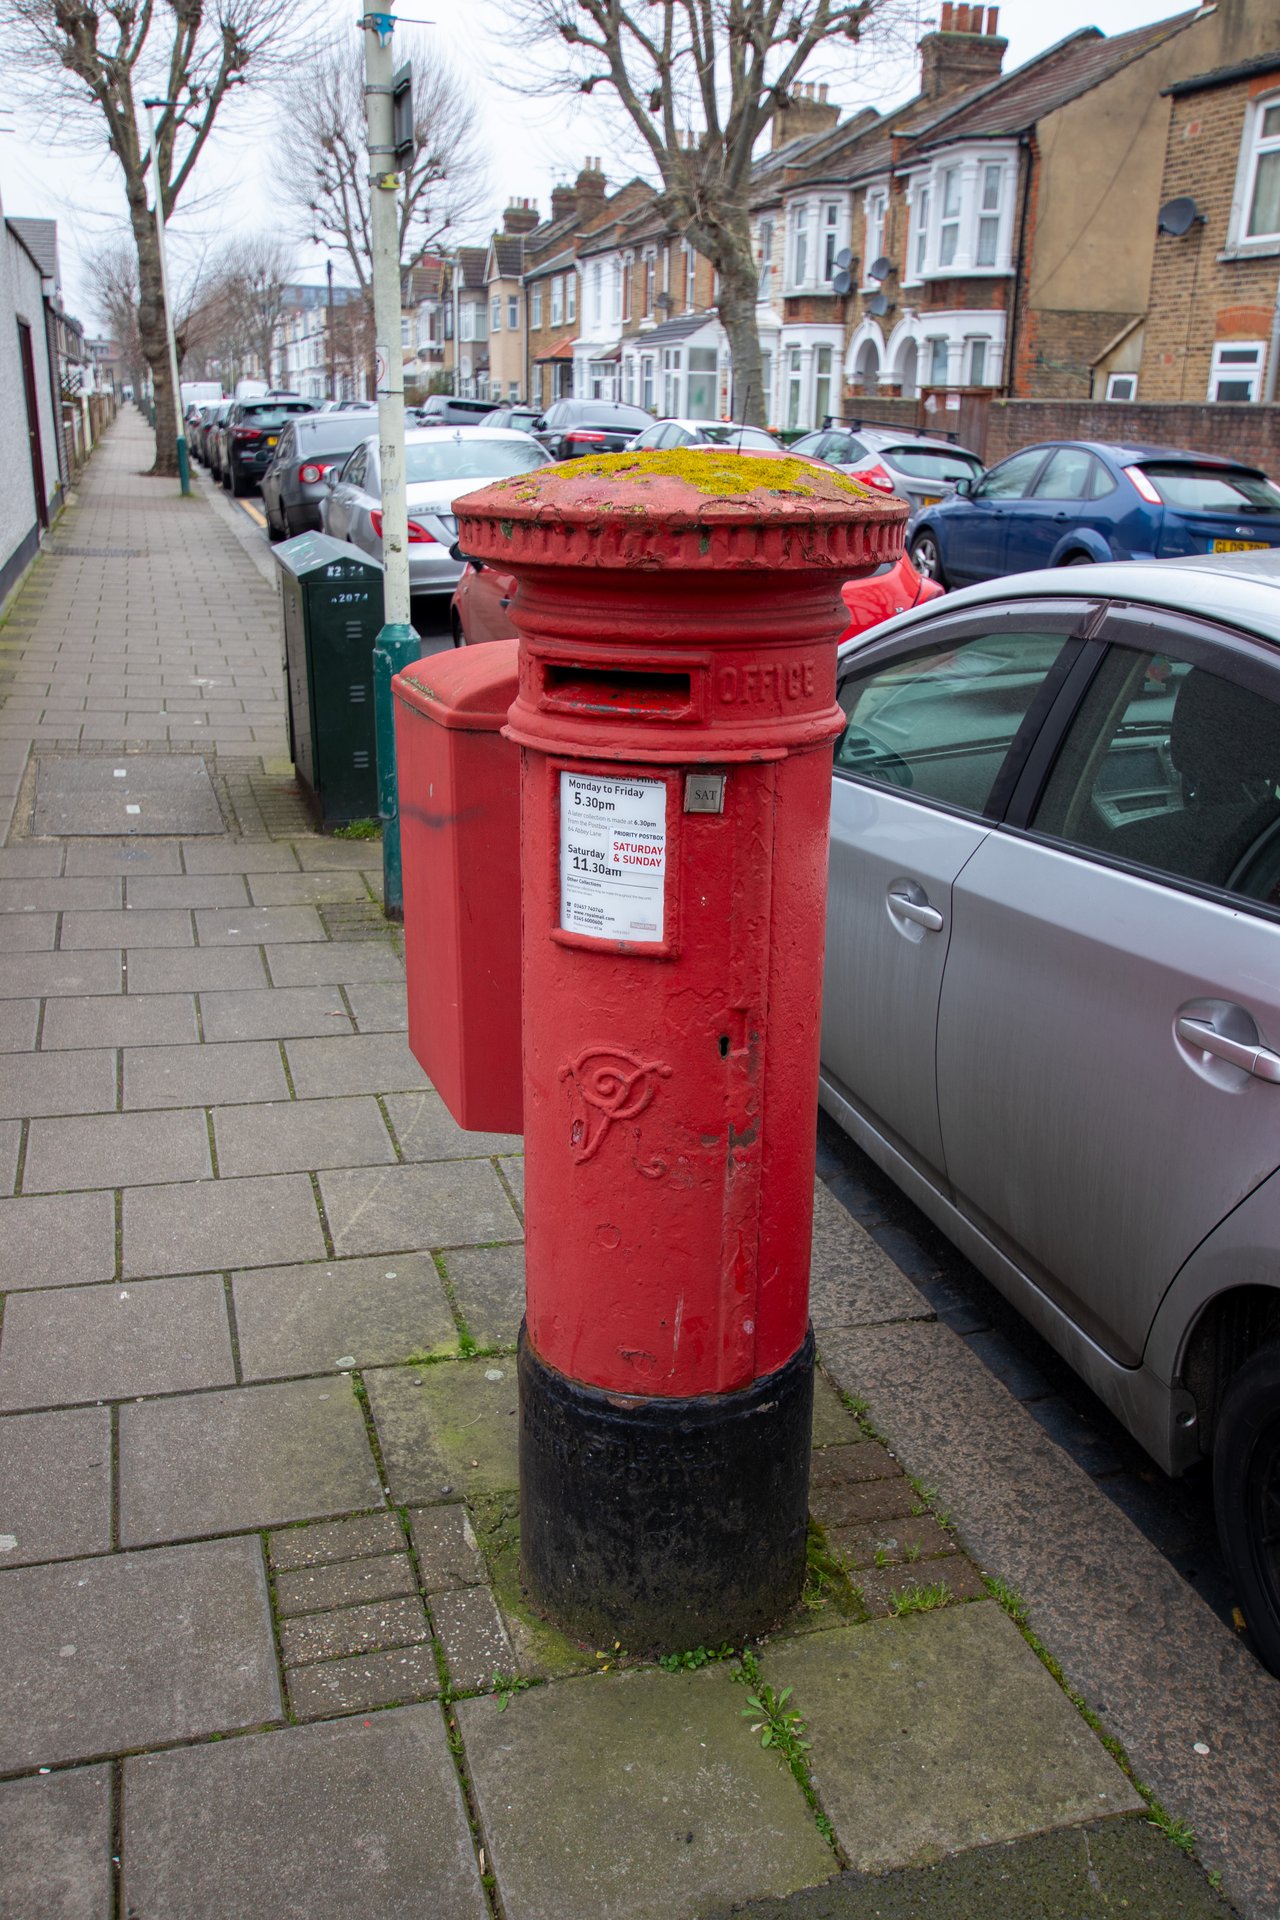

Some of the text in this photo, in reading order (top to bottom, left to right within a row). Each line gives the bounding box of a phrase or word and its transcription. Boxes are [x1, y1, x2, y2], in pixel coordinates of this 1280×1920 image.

[719, 660, 815, 704] OFFICE
[568, 779, 601, 794] Monday
[603, 785, 613, 794] to
[615, 786, 644, 799] Friday
[694, 790, 718, 801] SAT
[574, 792, 615, 811] 5.30pm
[583, 812, 606, 822] collection
[634, 819, 657, 828] 6.30pm
[614, 830, 664, 841] PRIORITY POSTBOX
[568, 844, 606, 861] Saturday
[613, 841, 664, 856] SATURDAY
[573, 856, 622, 877] 11.30am
[613, 853, 662, 868] & SUNDAY
[579, 878, 602, 888] Collections
[573, 909, 615, 922] www.royalmail.com
